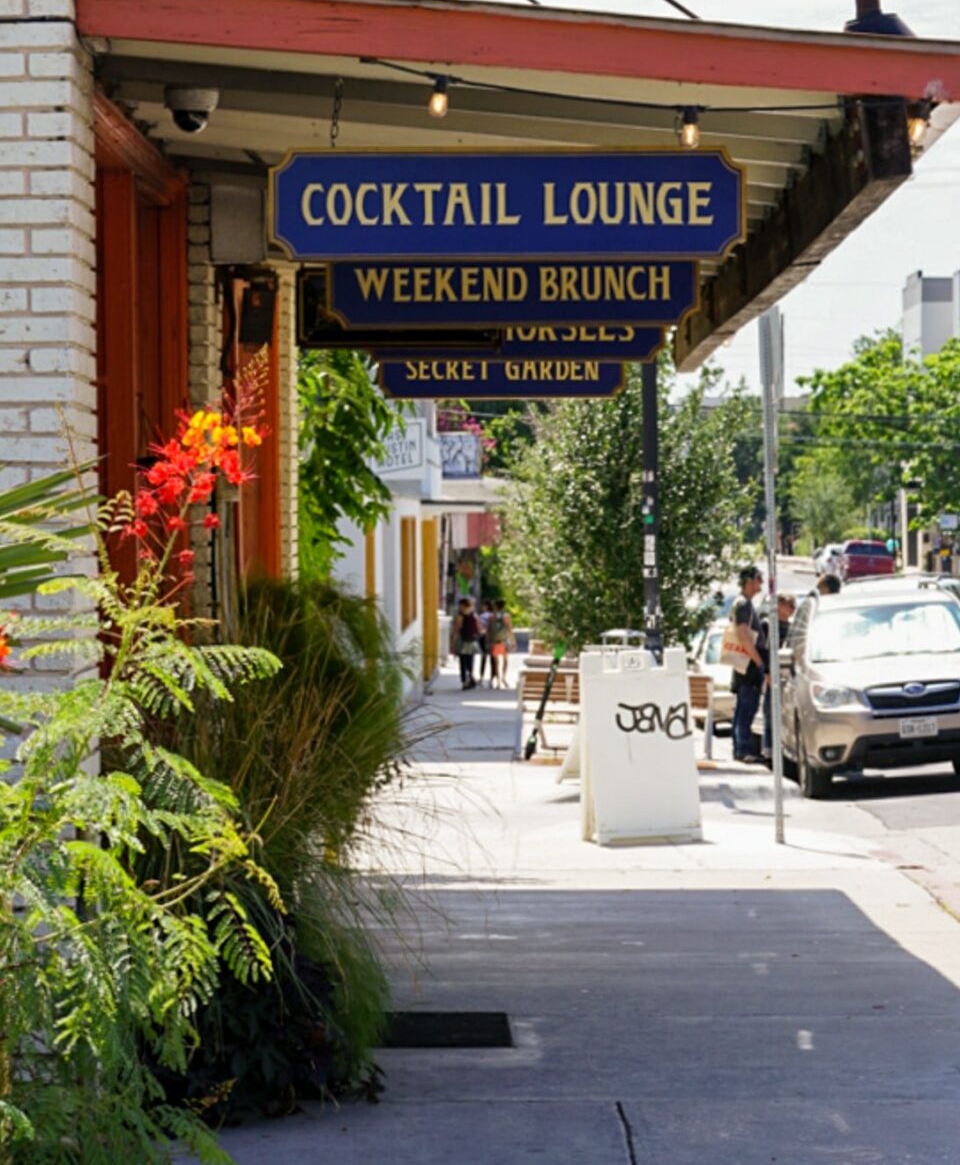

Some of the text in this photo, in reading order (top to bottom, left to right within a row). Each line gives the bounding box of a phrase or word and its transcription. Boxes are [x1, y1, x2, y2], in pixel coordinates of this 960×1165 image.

[300, 180, 715, 227] COCKTAIL LOUNGE
[354, 265, 672, 303] WEEKEND BRUNCH
[405, 360, 600, 381] SECRET GARDEN
